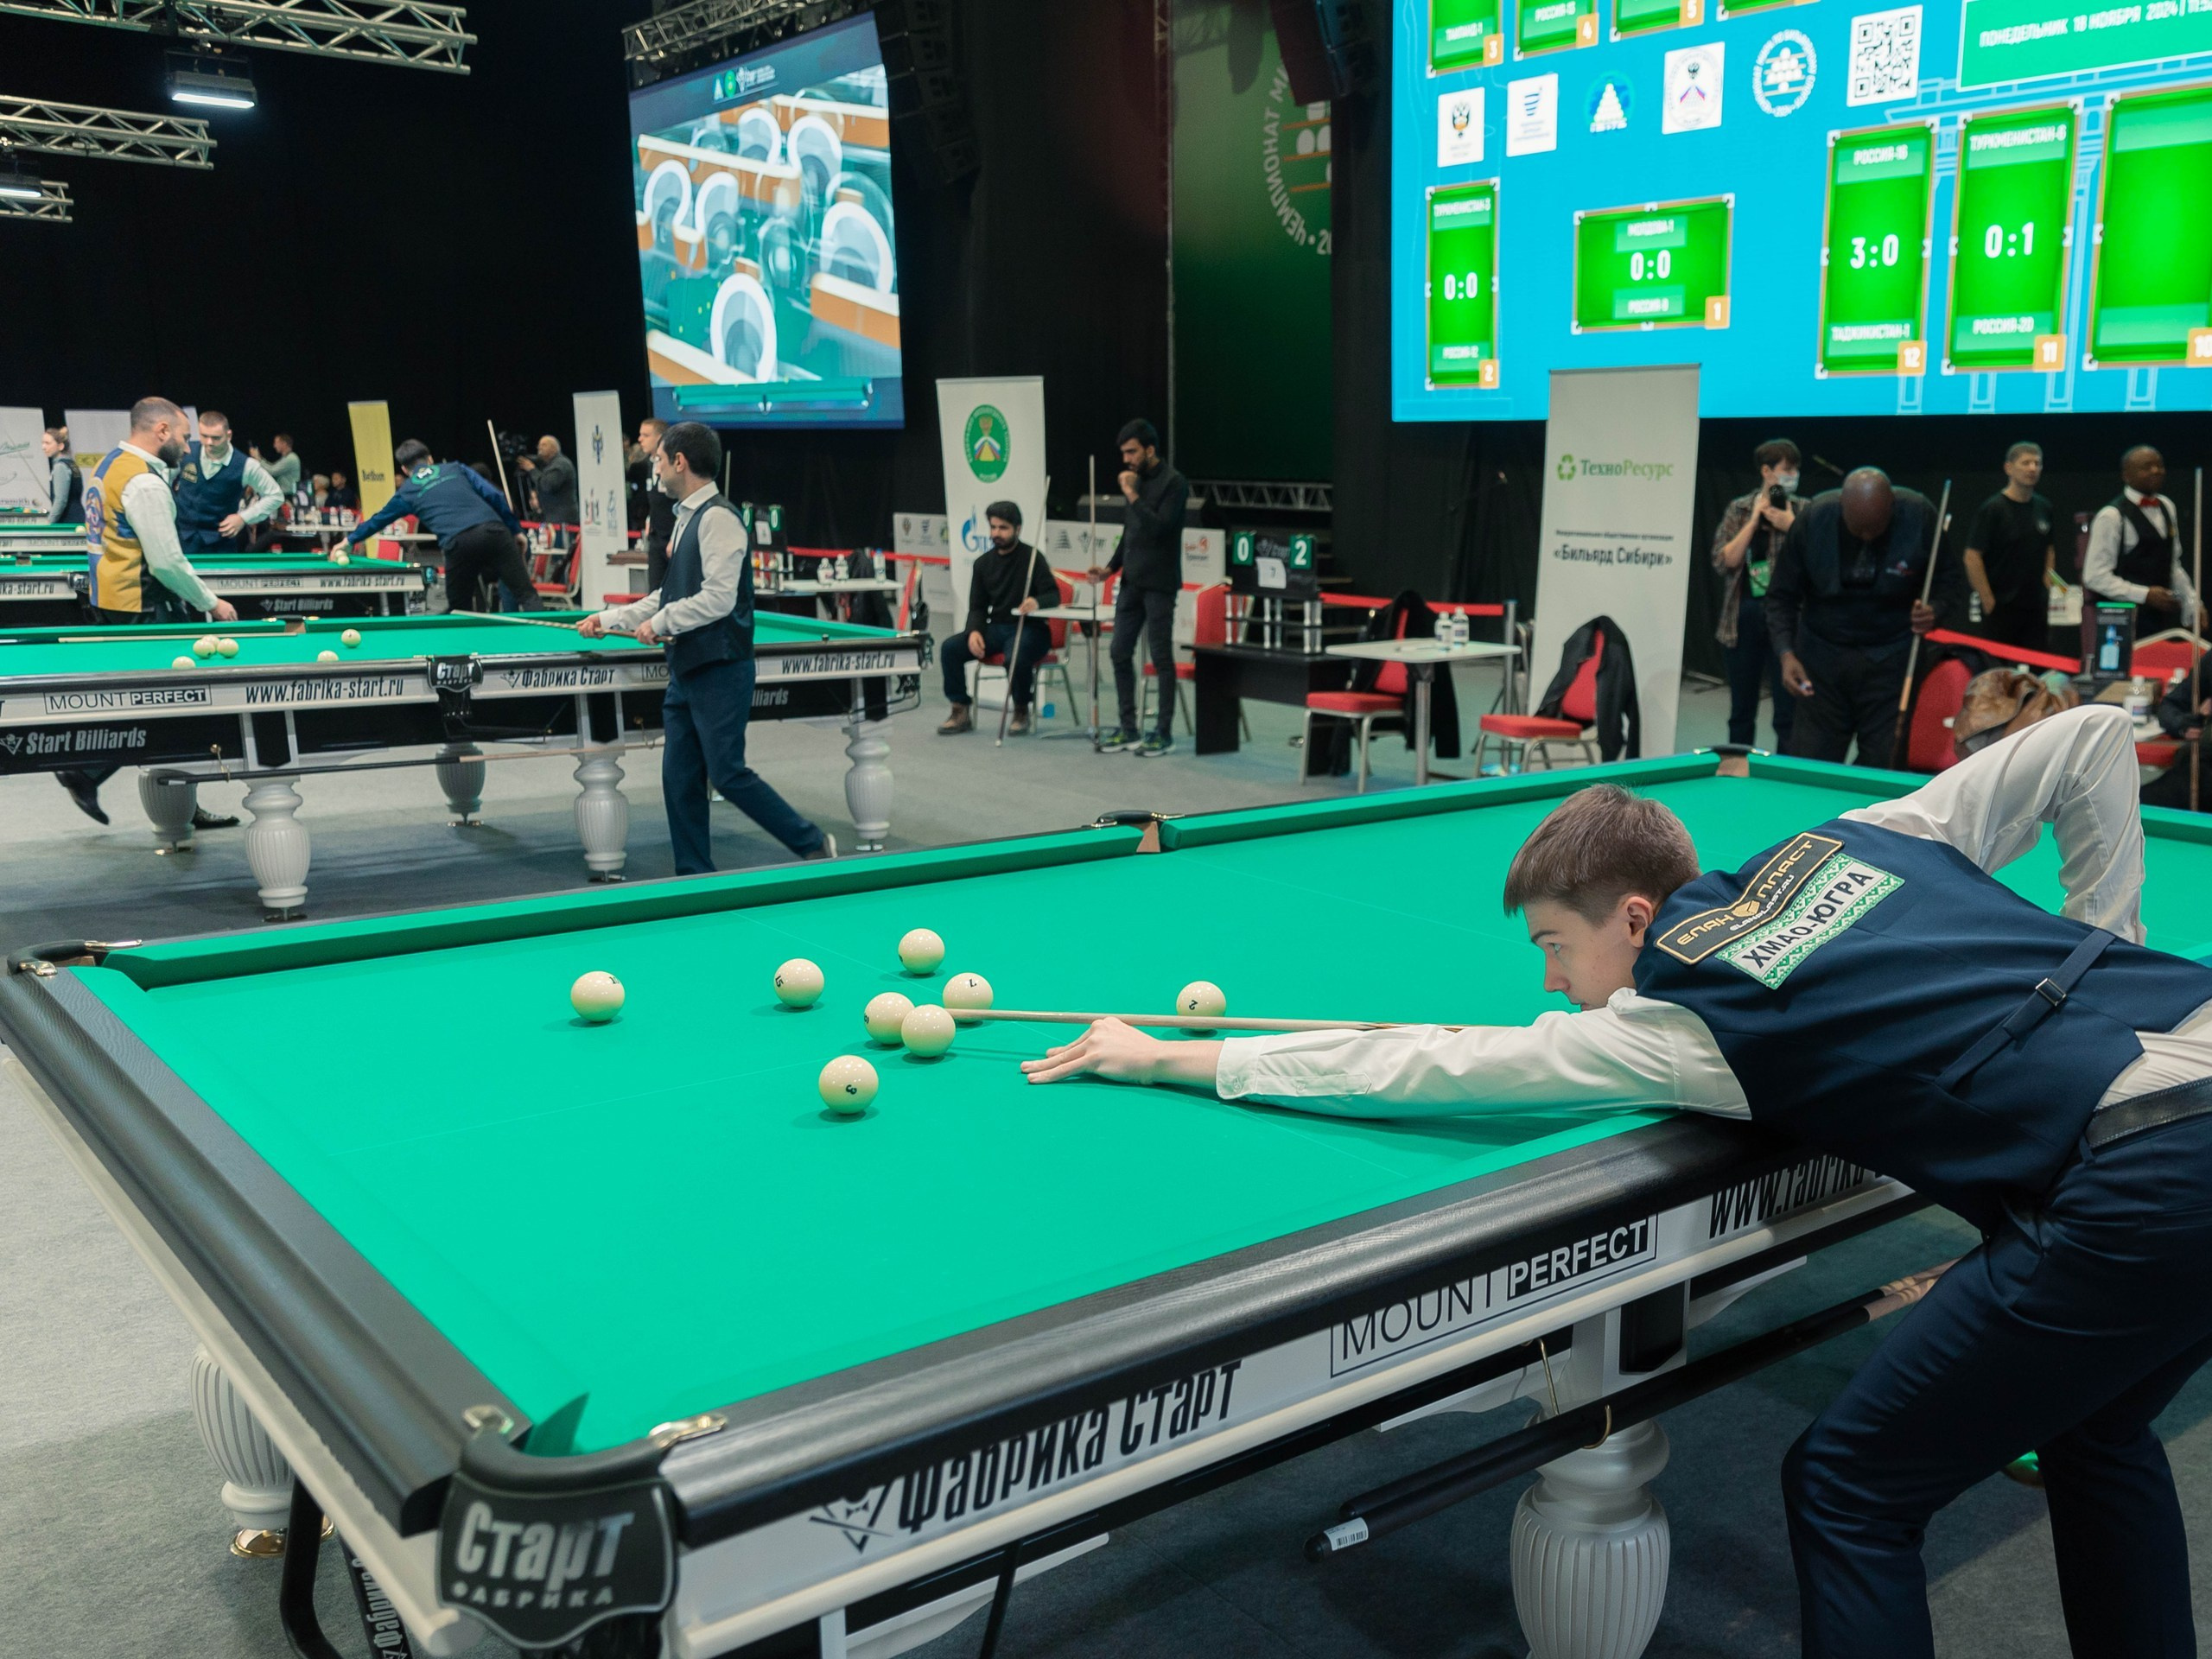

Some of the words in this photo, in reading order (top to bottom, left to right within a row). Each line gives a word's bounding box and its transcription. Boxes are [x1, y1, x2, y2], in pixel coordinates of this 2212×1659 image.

[1582, 21, 1592, 40] 4
[1979, 18, 2069, 48] ПОНЕДЕЛЬНИК
[2088, 5, 2142, 29] НОЯБРЯ
[1489, 40, 1497, 59] 3
[1262, 106, 1306, 246] ЧЕМПИОНАТ
[1850, 234, 1899, 270] 3:0
[1985, 222, 2035, 258] 0:1
[1630, 249, 1671, 282] 0:0
[1444, 272, 1478, 301] 0:0
[1713, 302, 1722, 321] 1
[1904, 346, 1921, 369] 12
[2042, 341, 2058, 363] 11
[1484, 364, 1494, 382] 2
[1580, 459, 1674, 481] ТехноРесурс
[1237, 537, 1249, 562] 0
[1294, 540, 1307, 566] 2
[1554, 543, 1614, 566] «Бильярд
[1617, 546, 1674, 569] Сибири»
[436, 662, 475, 684] Старт
[781, 652, 896, 675] www.fabrika-start.ru
[245, 676, 404, 704] www.fabrika-start.ru
[521, 669, 577, 689] Фабрика
[580, 666, 615, 685] Старт
[50, 691, 127, 710] MOUNT
[130, 689, 205, 705] PERFECT
[751, 688, 789, 707] lliards
[26, 731, 72, 755] Start
[74, 727, 147, 751] Billiards
[1676, 913, 1734, 946] ЕЛАН
[1756, 840, 1813, 899] ПЛАСТ
[1741, 870, 1873, 969] ХМАО-ЮГРА
[1509, 1218, 1648, 1298] PERFECT
[897, 1406, 1110, 1535] Фабрика
[1120, 1360, 1243, 1457] Старт
[455, 1501, 636, 1592] Старт
